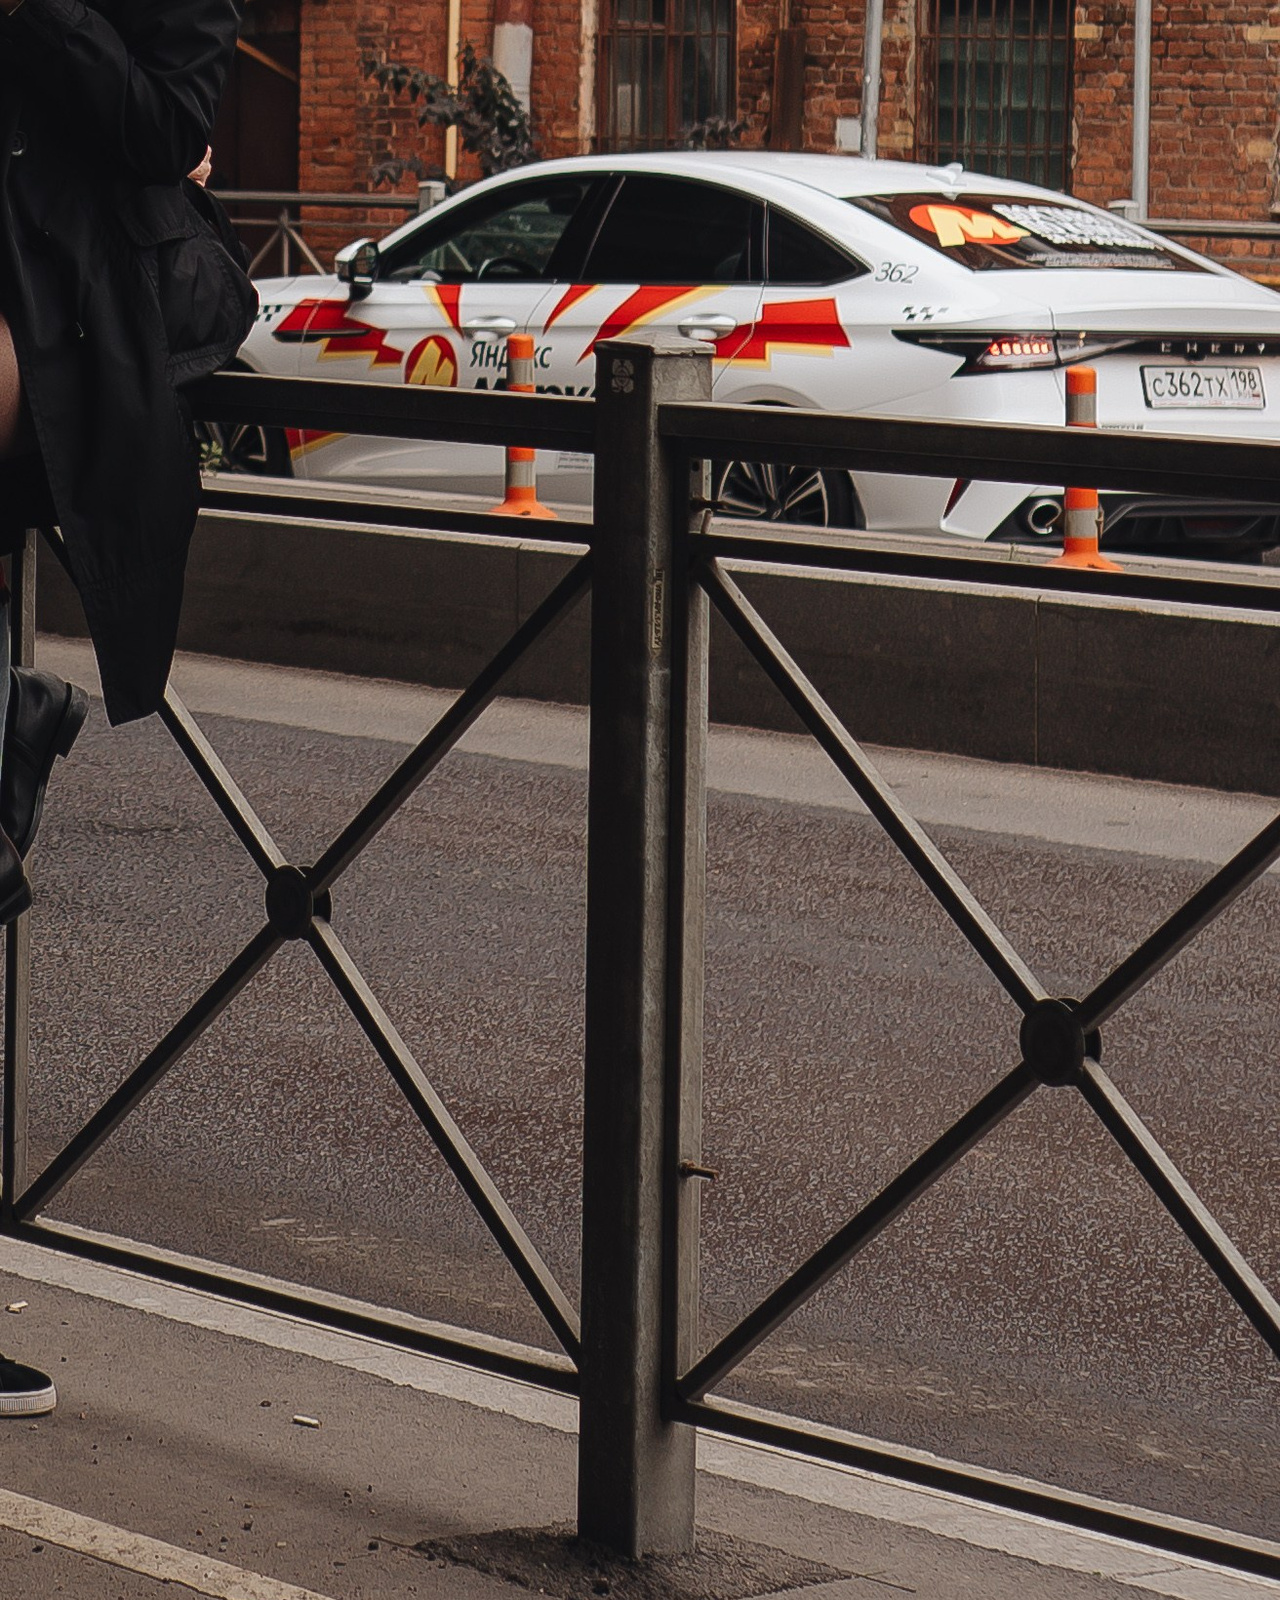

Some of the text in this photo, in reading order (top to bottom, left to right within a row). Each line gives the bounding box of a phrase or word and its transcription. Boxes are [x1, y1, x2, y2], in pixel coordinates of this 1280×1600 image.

[874, 261, 919, 284] 362
[470, 340, 552, 372] Яндкс
[1230, 369, 1258, 391] 198
